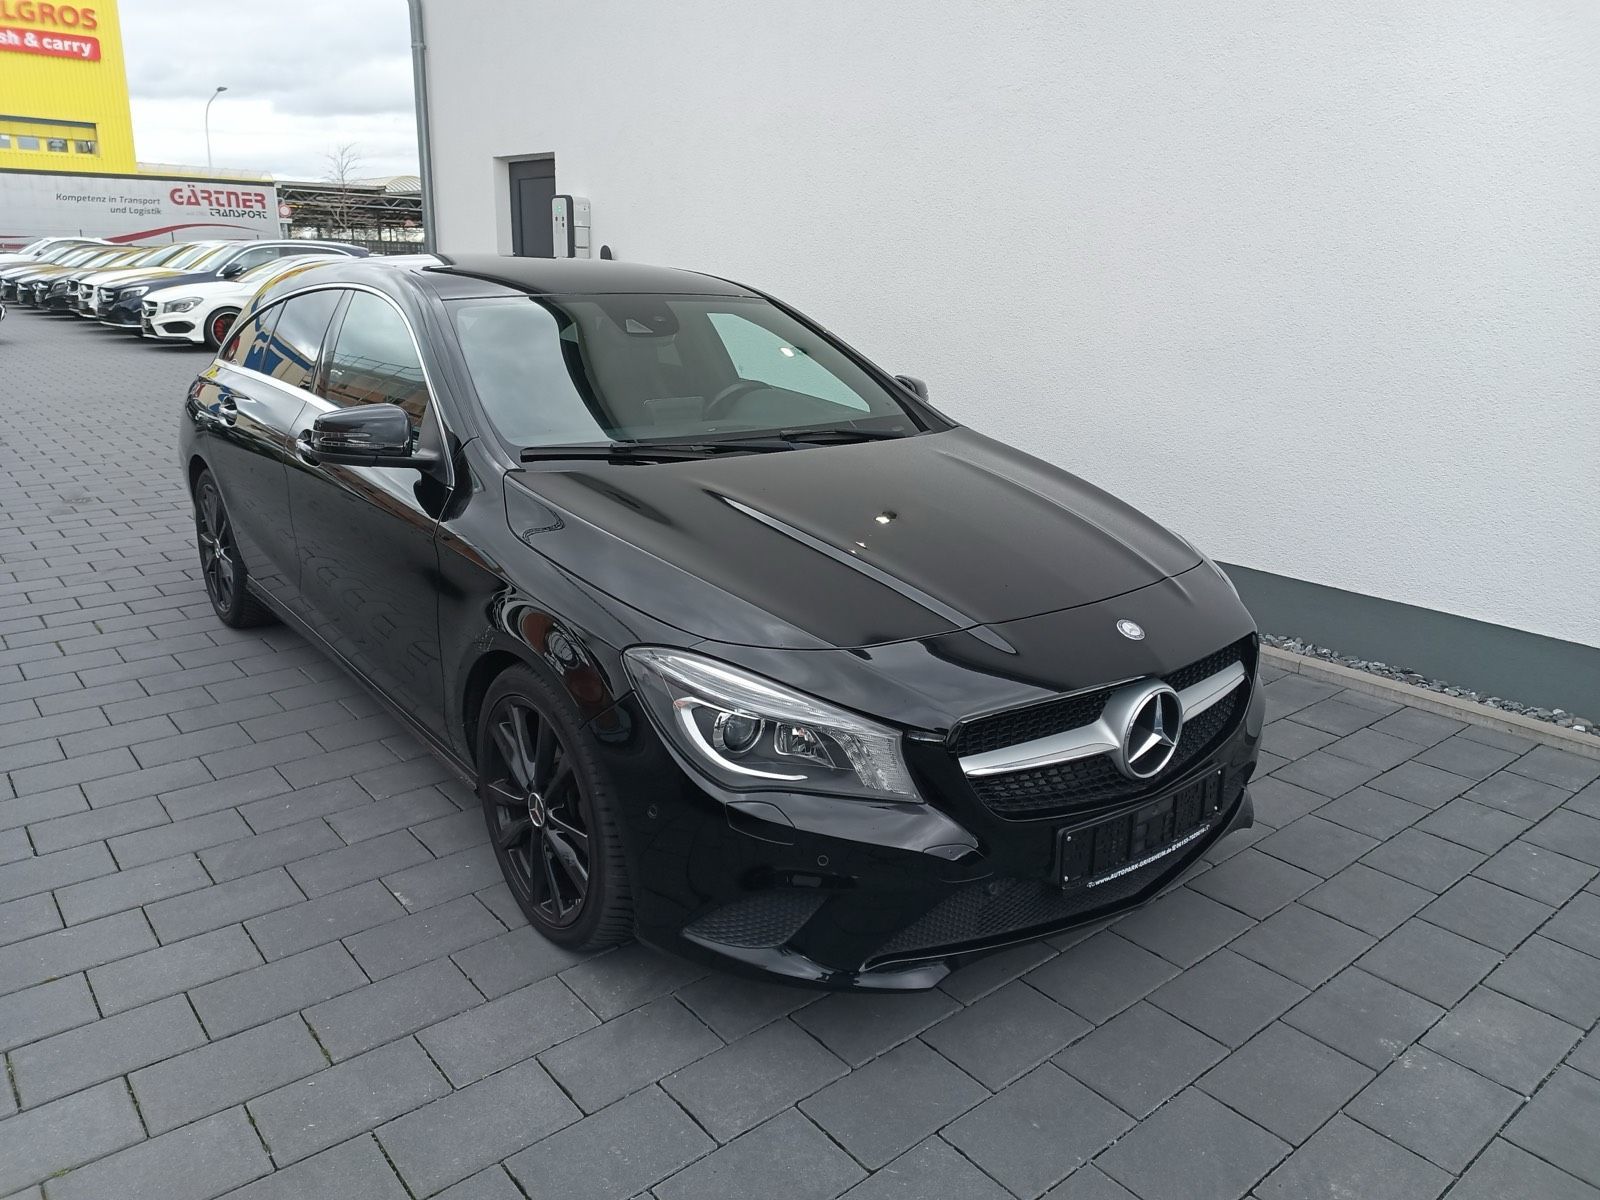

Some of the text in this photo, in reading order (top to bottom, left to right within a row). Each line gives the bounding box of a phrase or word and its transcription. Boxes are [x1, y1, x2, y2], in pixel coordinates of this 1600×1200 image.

[24, 32, 39, 48] &
[42, 37, 92, 57] carry
[56, 193, 107, 204] Kompetenz
[120, 196, 161, 206] Transport
[169, 184, 267, 210] GÄRTNER
[110, 206, 162, 217] und Logistik
[209, 208, 268, 220] TRANSPORT
